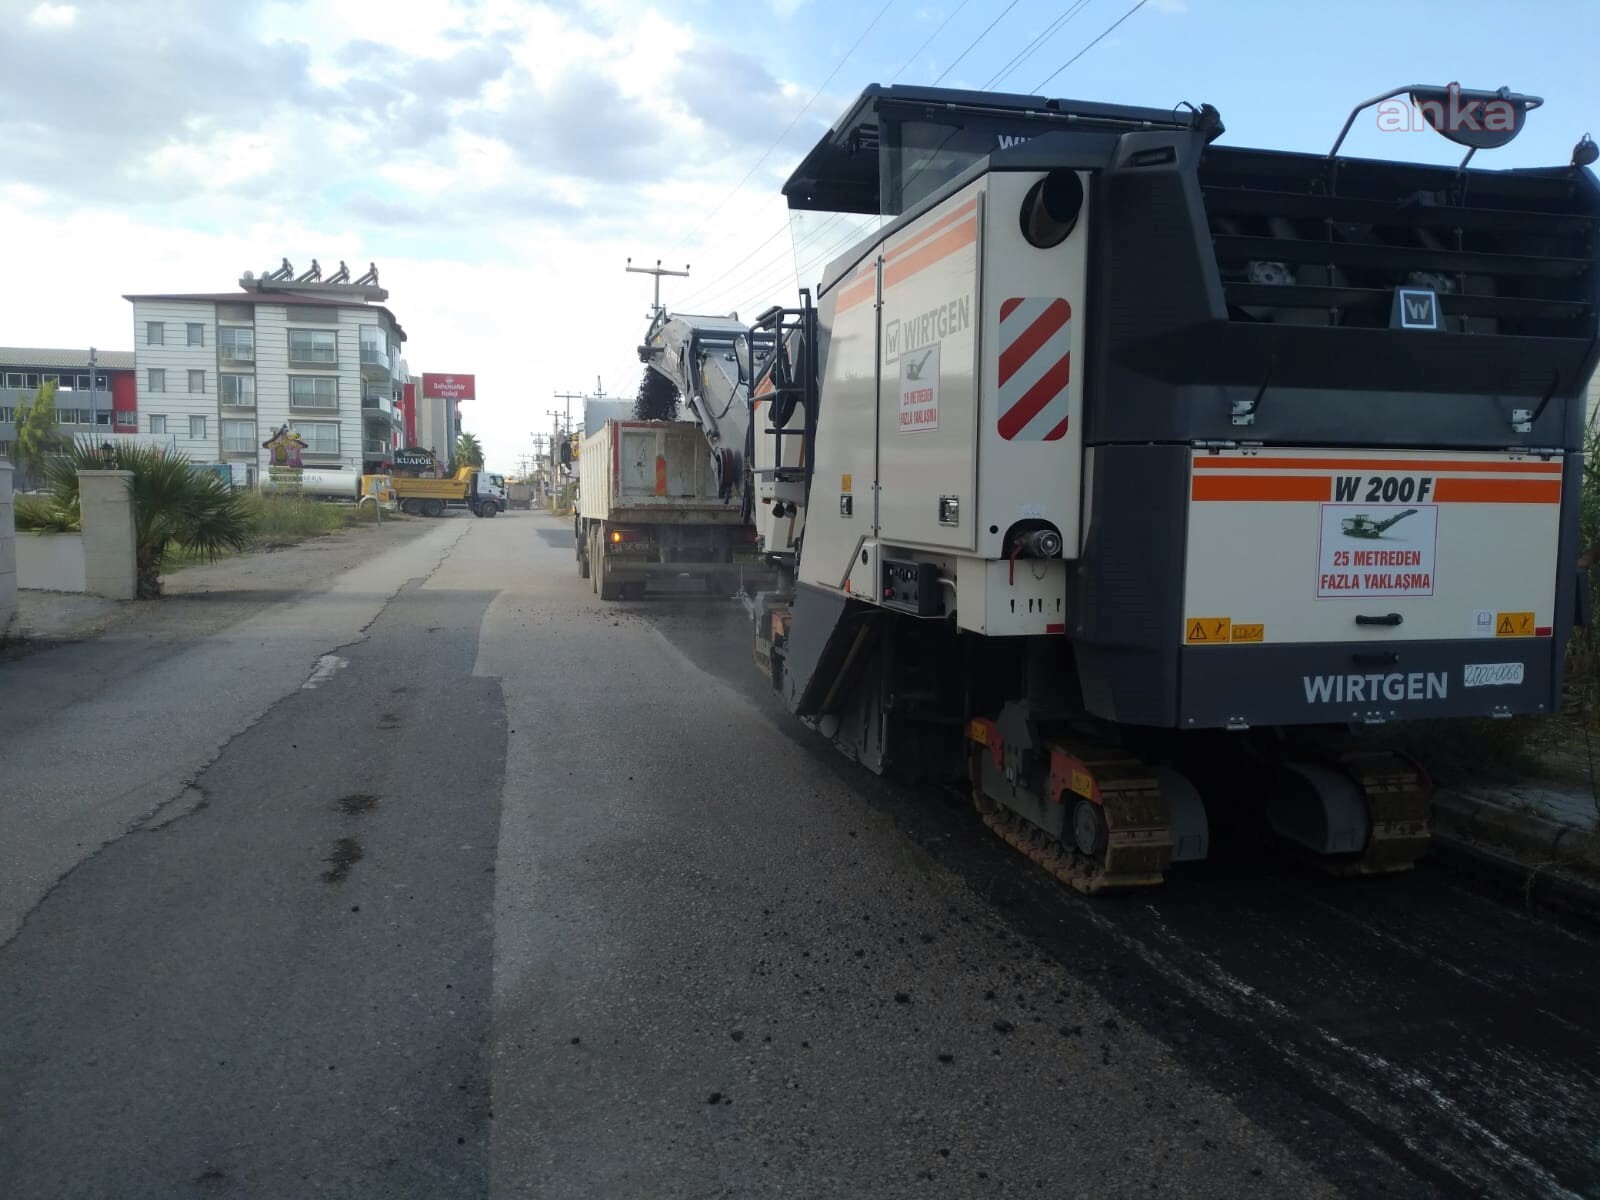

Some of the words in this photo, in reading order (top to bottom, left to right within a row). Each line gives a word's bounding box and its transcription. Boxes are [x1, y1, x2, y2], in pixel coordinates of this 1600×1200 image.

[904, 295, 969, 350] WIRTGEN
[1335, 476, 1362, 502] W
[1333, 551, 1350, 567] 25
[1353, 551, 1421, 566] METREDEN
[1321, 574, 1360, 589] FAZLA
[1364, 573, 1430, 591] YAKLAŞMA
[1303, 671, 1448, 704] WIRTGEN
